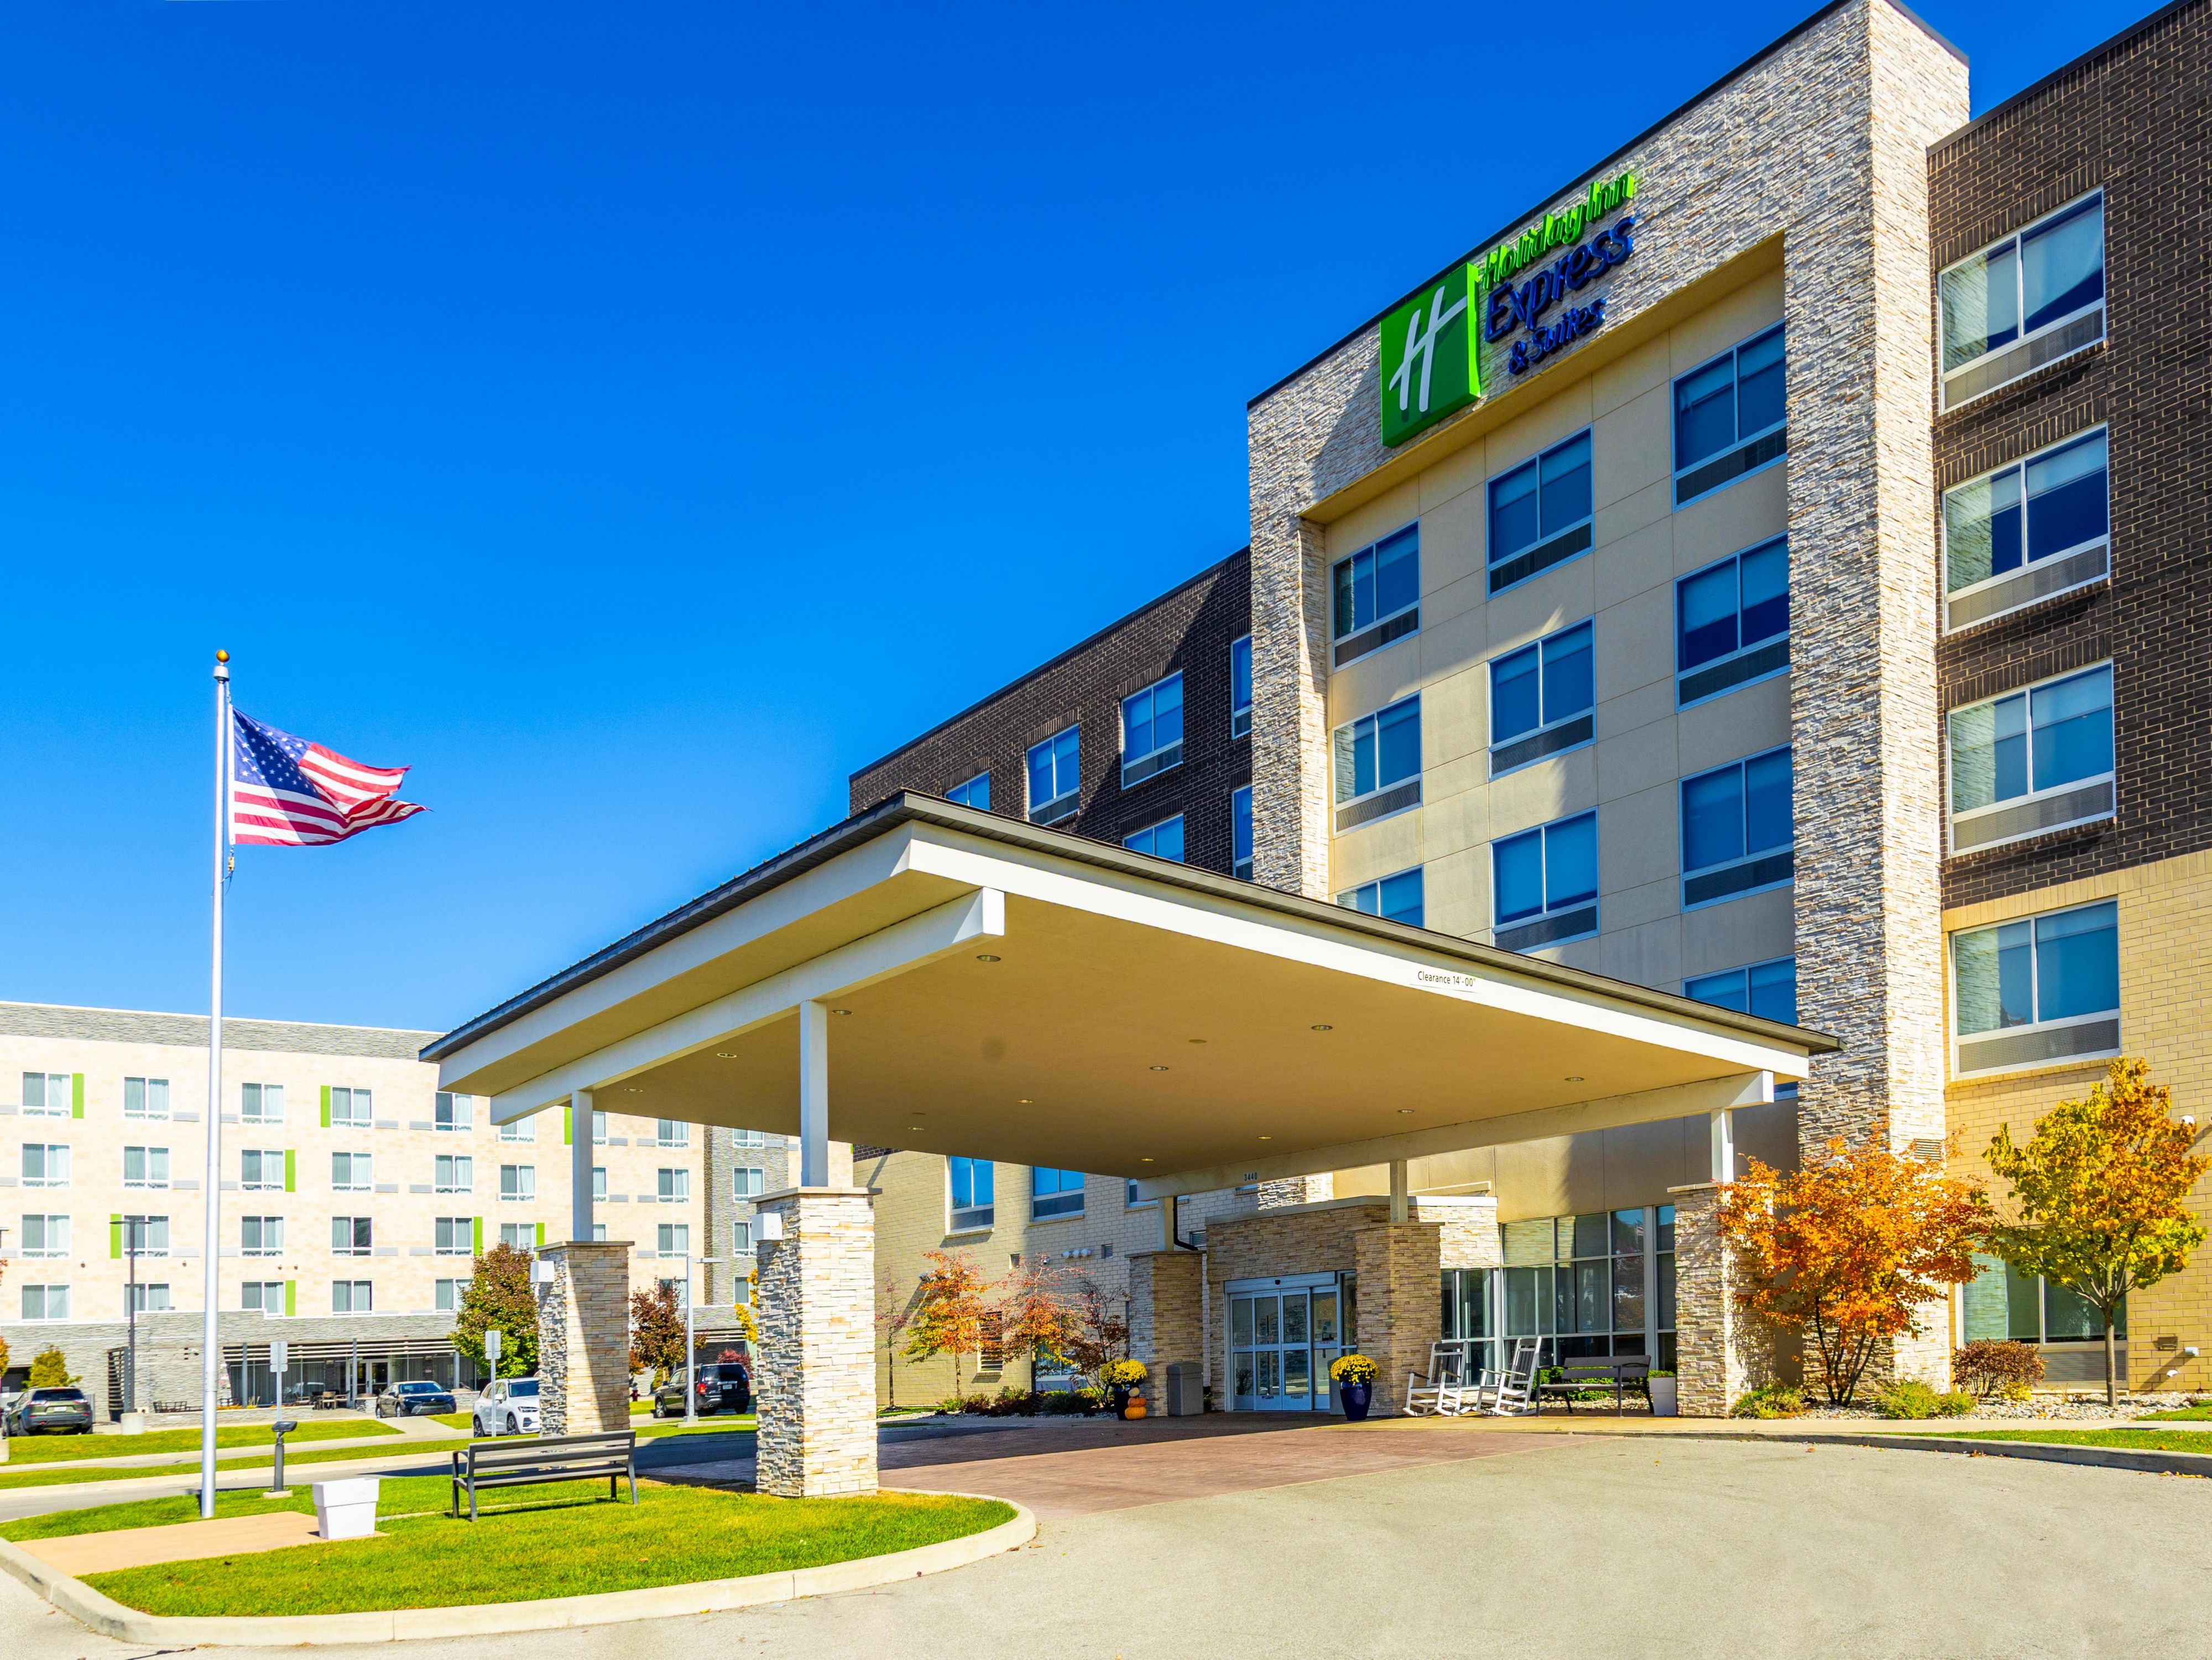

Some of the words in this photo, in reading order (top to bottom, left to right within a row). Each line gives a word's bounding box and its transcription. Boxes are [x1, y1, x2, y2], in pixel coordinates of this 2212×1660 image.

[1483, 203, 1585, 290] Holiday
[1586, 173, 1635, 223] Inn
[1484, 216, 1636, 344] Express
[1508, 341, 1528, 375] &
[1527, 298, 1606, 363] Suites
[1417, 971, 1451, 984] Clearance
[1244, 1172, 1258, 1182] 3440
